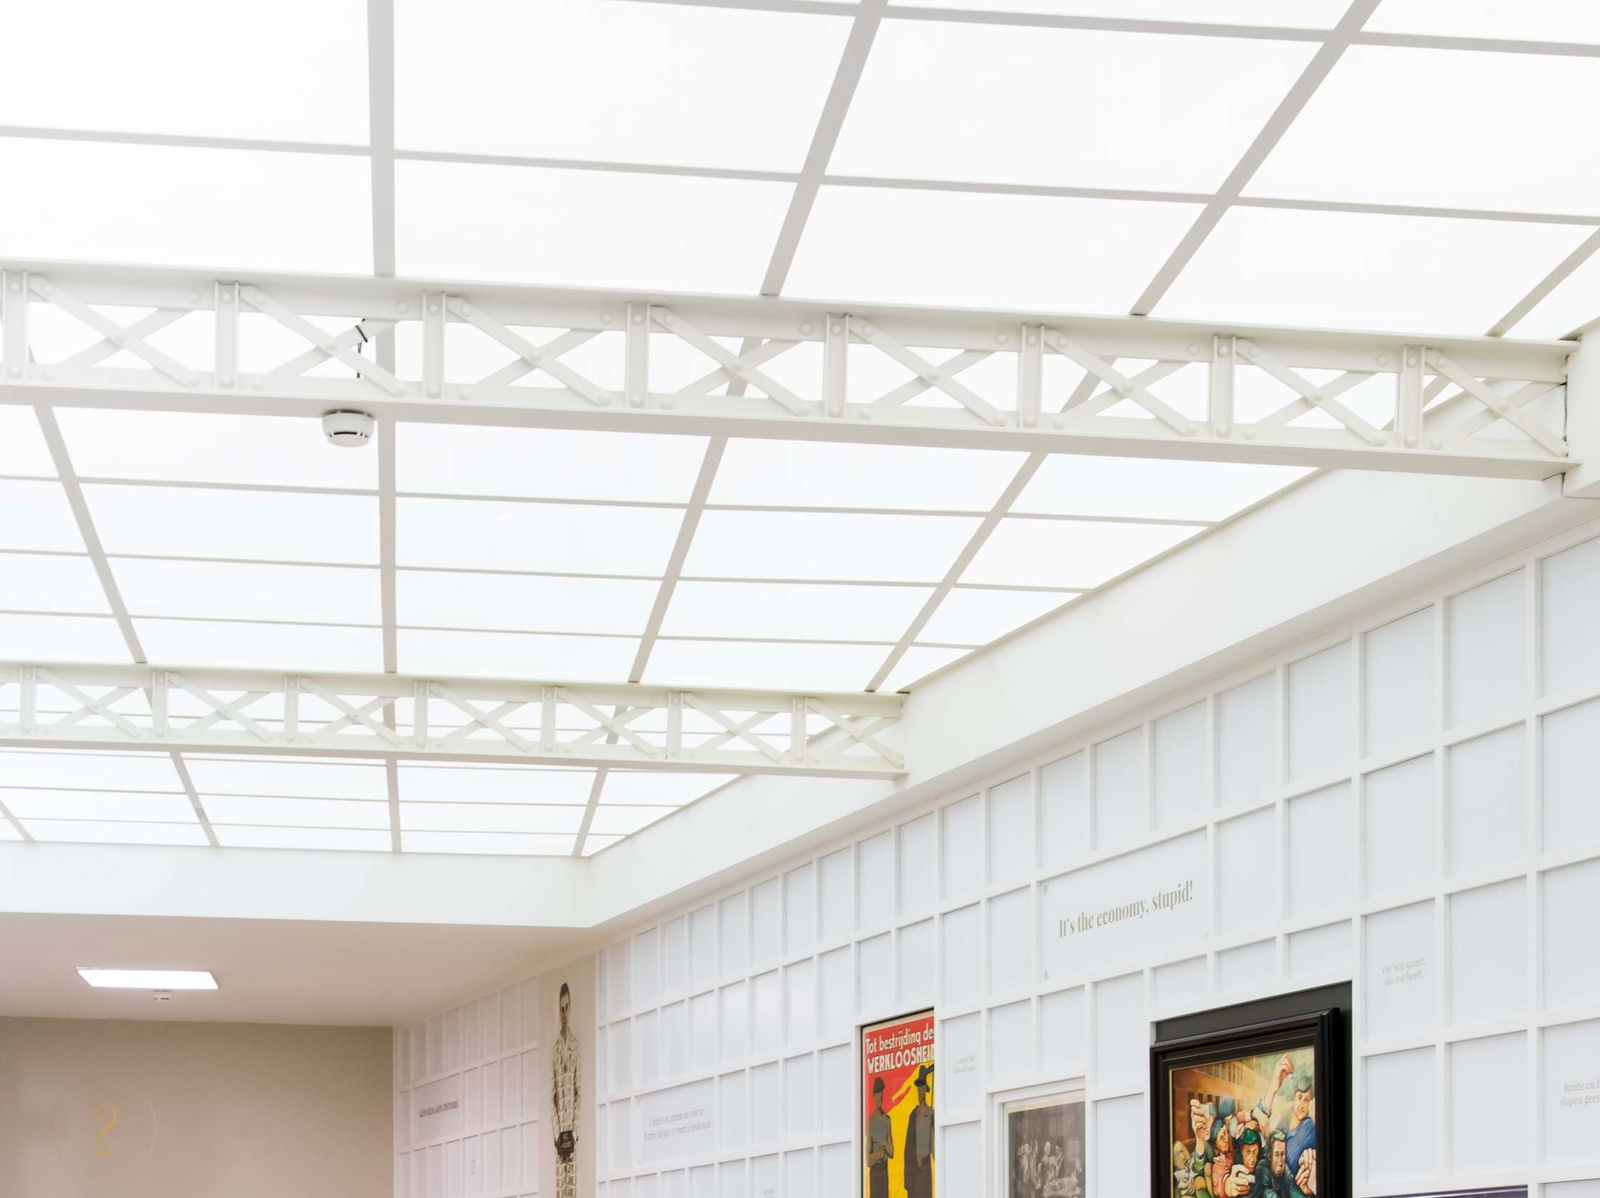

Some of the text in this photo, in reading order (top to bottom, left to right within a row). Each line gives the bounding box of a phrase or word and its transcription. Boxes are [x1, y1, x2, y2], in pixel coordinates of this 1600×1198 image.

[1059, 880, 1193, 938] It's the economy, stupid!
[866, 1037, 877, 1054] Tot
[879, 1028, 921, 1052] bestrijding
